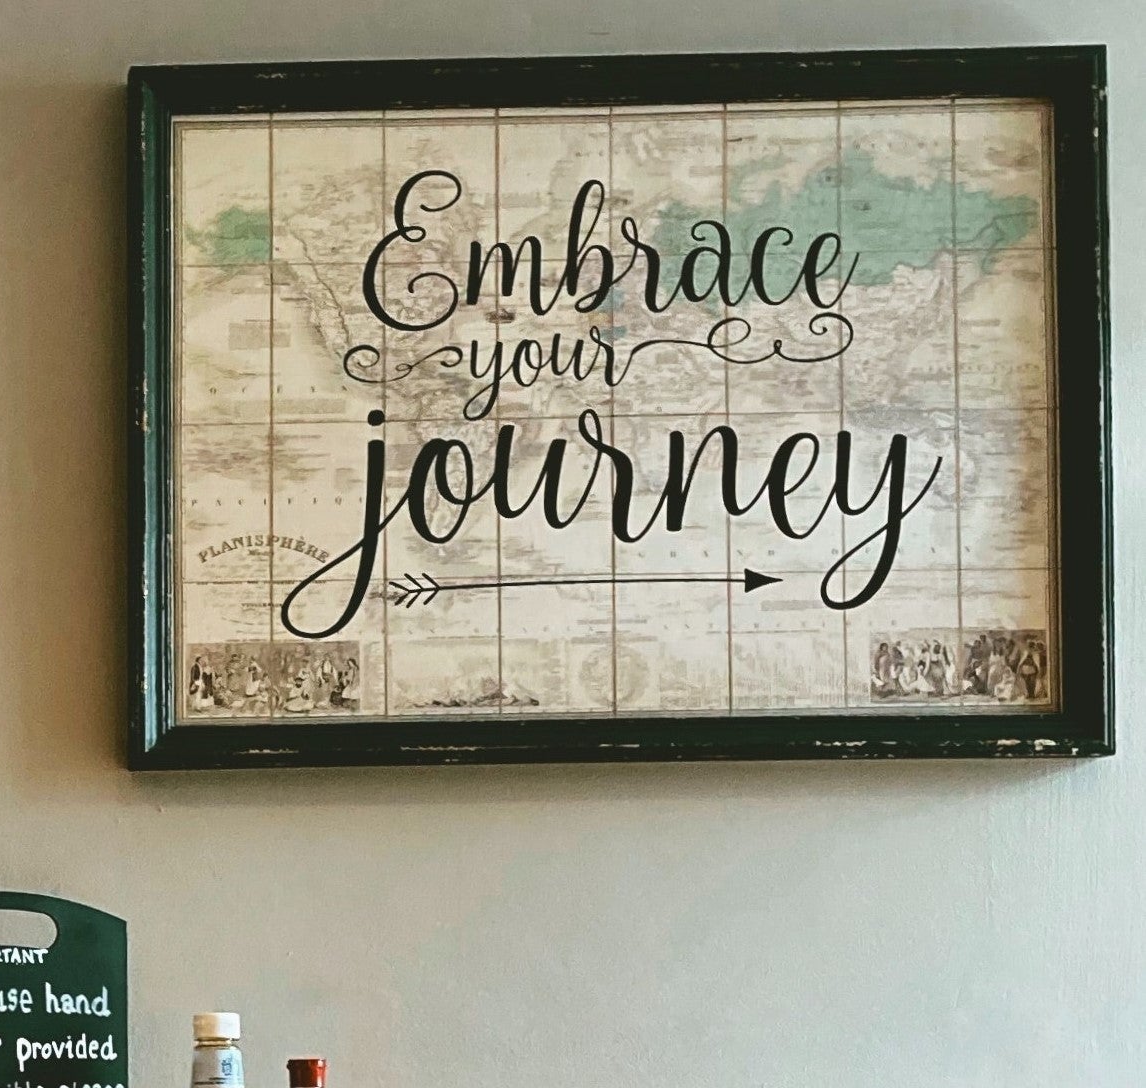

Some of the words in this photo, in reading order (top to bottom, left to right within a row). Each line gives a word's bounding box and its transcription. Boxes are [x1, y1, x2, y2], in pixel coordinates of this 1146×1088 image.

[362, 170, 860, 331] Embrace
[281, 409, 942, 640] journey
[45, 981, 112, 1018] hand
[16, 1032, 118, 1073] provided
